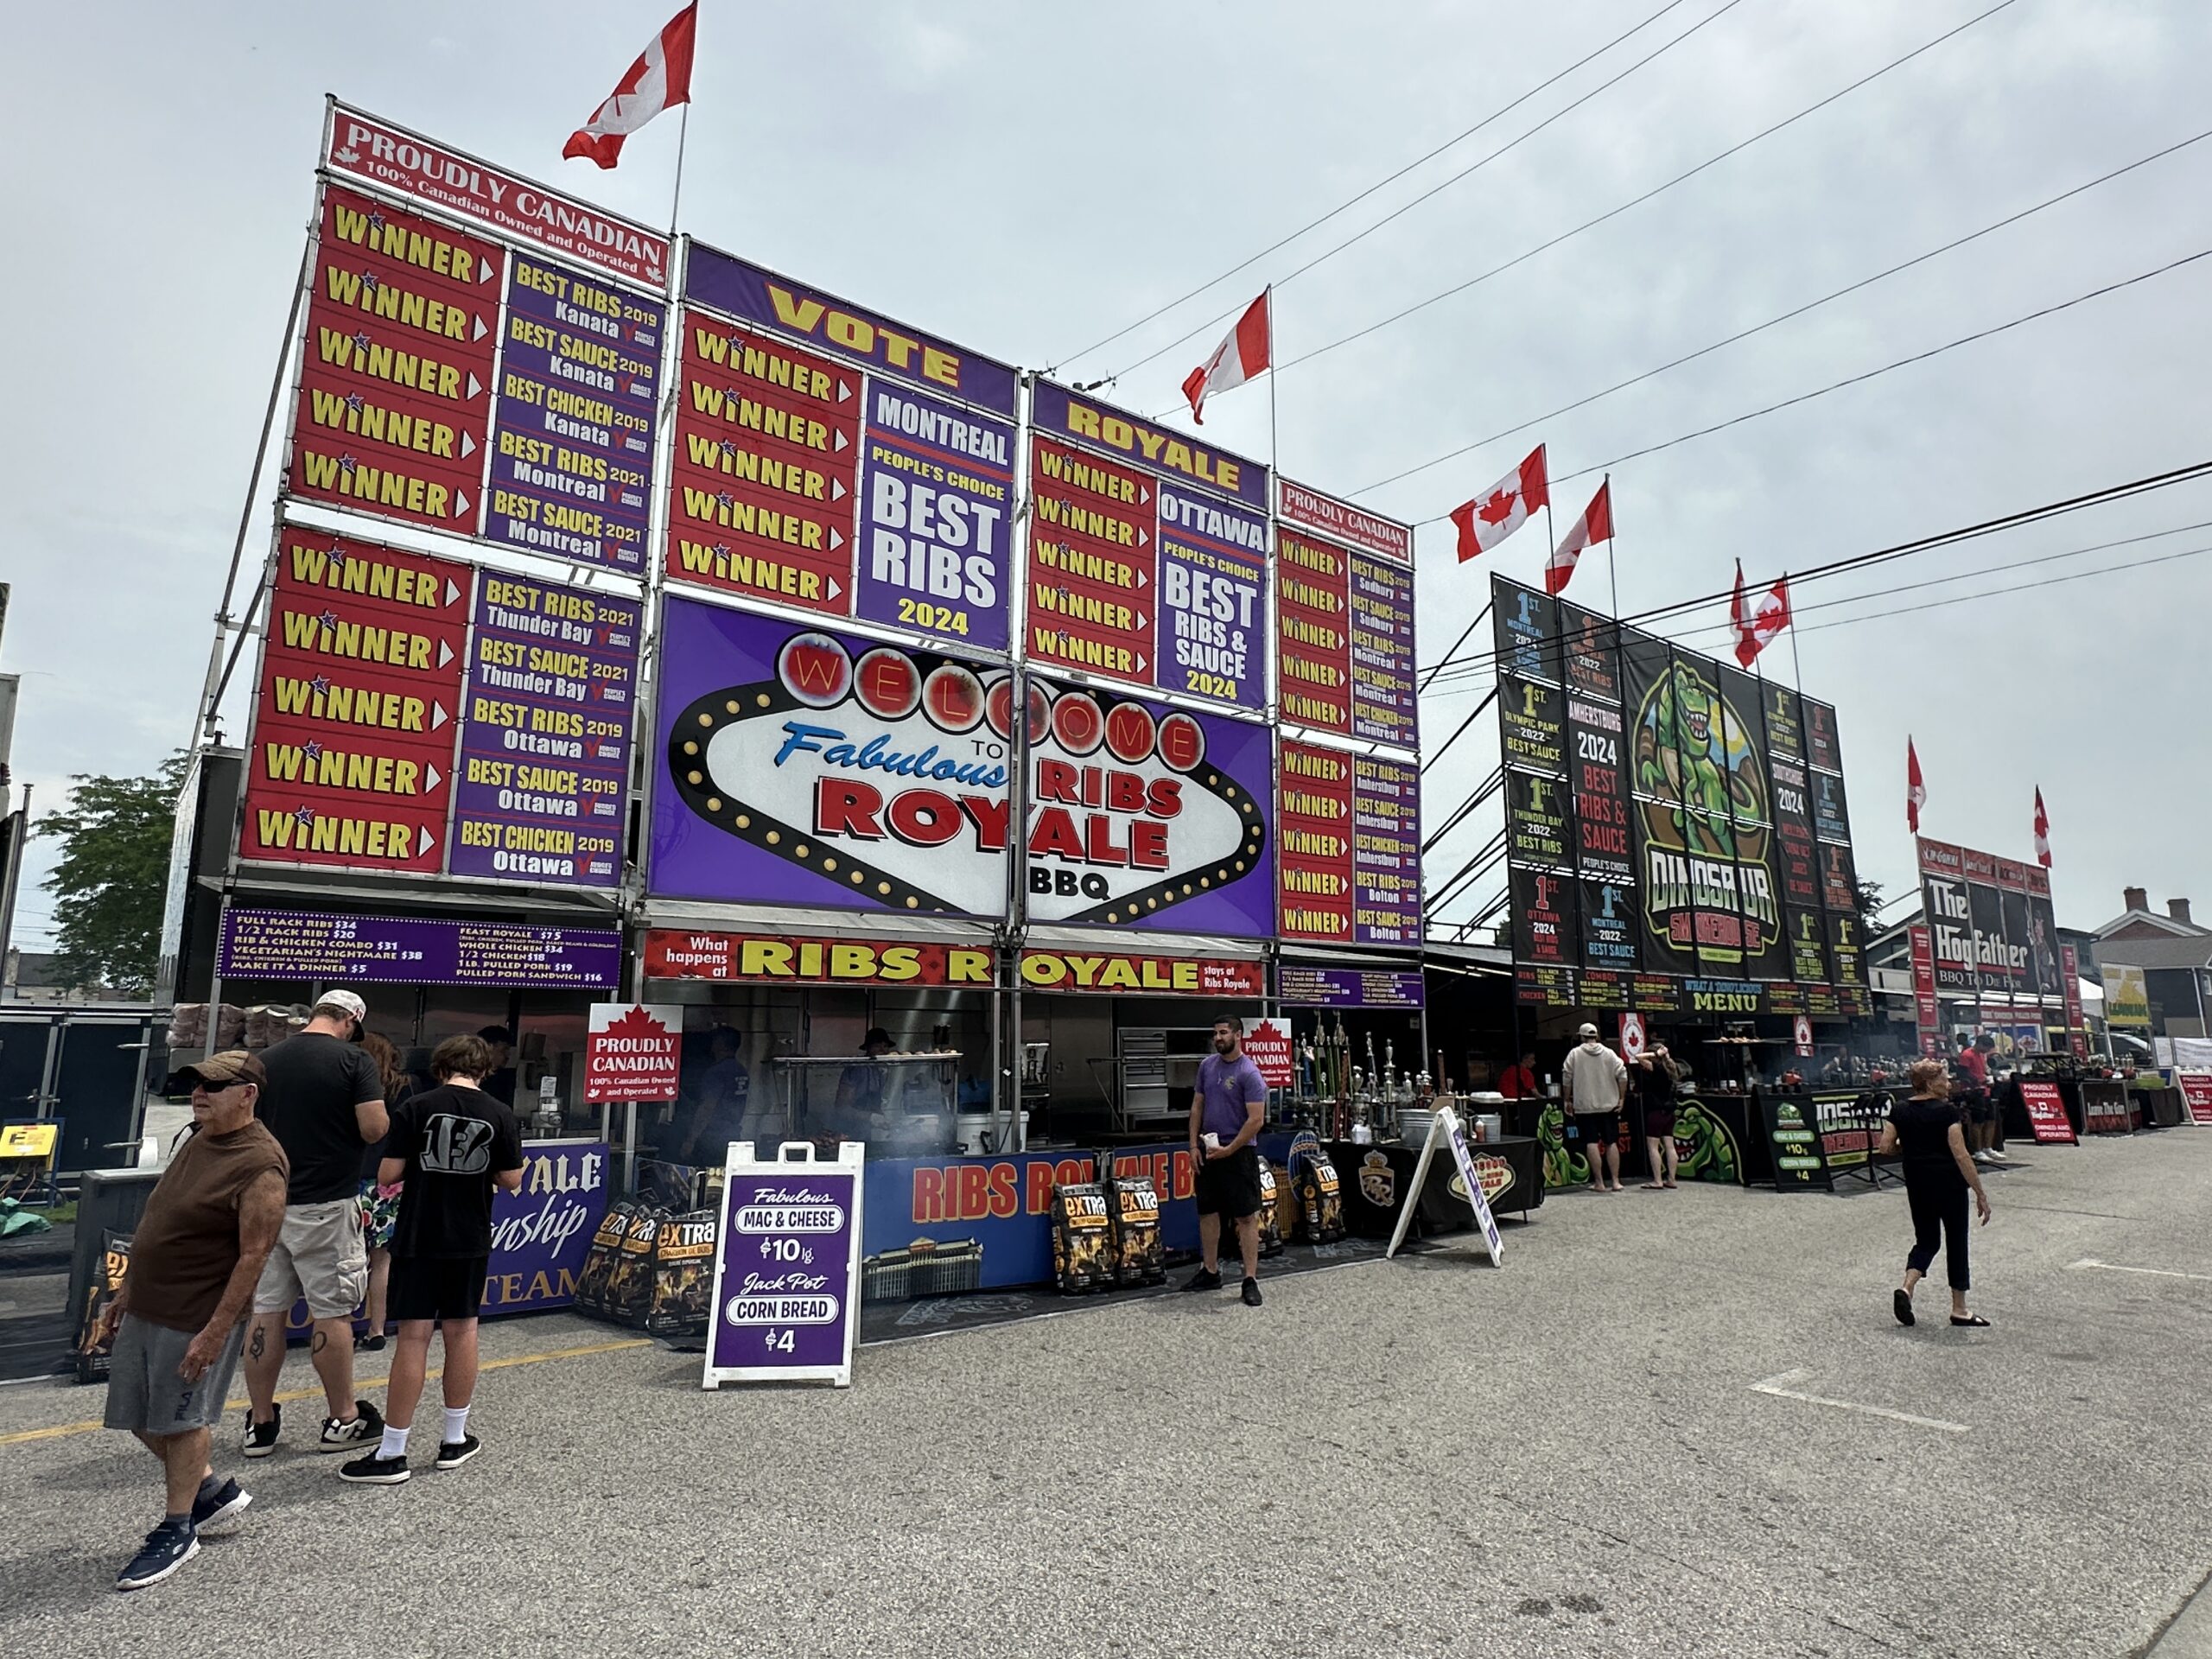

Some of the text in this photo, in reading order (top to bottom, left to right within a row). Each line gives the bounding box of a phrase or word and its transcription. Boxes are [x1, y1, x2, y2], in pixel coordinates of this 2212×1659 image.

[348, 123, 660, 265] PROUDLY CANADIAN
[367, 162, 638, 273] 100% Canadian Owned and Operated
[517, 263, 657, 327] BEST RIBS 2019
[556, 303, 620, 339] Kanata
[767, 283, 961, 388] VOTE
[505, 374, 648, 433] BEST CHICKEN 2019
[544, 412, 610, 447] Kanata
[877, 393, 1008, 466] MONTREAL
[499, 431, 645, 487] BEST RIBS 2021
[1068, 401, 1239, 492] ROYALE
[513, 461, 606, 501] Montreal
[873, 446, 1004, 501] PEOPLE'S CHOICE
[873, 471, 1001, 556] BEST
[1160, 493, 1264, 552] OTTAWA
[1287, 488, 1404, 546] PROUDLY CANADIAN
[873, 528, 995, 608] RIBS
[1165, 541, 1259, 582] PEOPLE'S CHOICE
[1351, 558, 1395, 586] BEST RIBS
[486, 579, 634, 626] BEST RIBS 2021
[1166, 561, 1257, 628] BEST
[1359, 577, 1394, 599] Sudbury
[487, 606, 593, 646] Thunder Bay
[898, 598, 969, 636] 2024
[1174, 610, 1247, 653] RIBS &
[1507, 619, 1544, 638] MONTREAL
[1176, 638, 1246, 680] SAUCE
[1186, 670, 1237, 700] 2024
[474, 697, 623, 738] BEST RIBS 2019
[1357, 721, 1398, 741] Montreal
[1505, 710, 1560, 734] OLYMPIC PARK
[1568, 700, 1622, 733] AMHERSTBURG
[504, 730, 582, 760] Ottawa
[774, 721, 1010, 788] Fabulous
[971, 740, 1003, 760] TO
[1507, 736, 1560, 761] BEST SAUCE
[1578, 731, 1618, 766] 2024
[1356, 760, 1400, 782] BEST RIBS
[1583, 764, 1617, 795] BEST
[1037, 757, 1183, 819] RIBS
[1778, 787, 1804, 815] 2024
[1514, 809, 1563, 827] THUNDER BAY
[1580, 792, 1626, 825] RIBS &
[461, 821, 614, 855] BEST CHICKEN 2019
[1516, 834, 1562, 854] BEST RIBS
[1583, 823, 1627, 855] SAUCE
[493, 850, 573, 876] Ottawa
[1610, 860, 1630, 873] CHOICE
[1029, 866, 1110, 900] BBQ
[1357, 871, 1401, 890] BEST RIBS
[1650, 850, 1774, 925] DINOSAUR
[1370, 889, 1400, 904] Bolton
[1928, 879, 1968, 919] The
[237, 916, 266, 925] FULL
[335, 921, 357, 930] $34
[1528, 910, 1560, 923] OTTAWA
[1534, 922, 1555, 935] 2024
[1592, 918, 1626, 930] MONTREAL
[325, 950, 397, 960] NIGHTMARE
[401, 951, 423, 960] $38
[544, 945, 563, 954] $34
[667, 949, 728, 966] happens
[690, 937, 728, 951] What
[1588, 942, 1636, 958] BEST SAUCE
[1935, 924, 2028, 970] Hogfather
[712, 965, 728, 977] at
[741, 939, 923, 981] RIBS
[1204, 966, 1235, 976] stays at
[528, 972, 582, 981] SANDWICH
[584, 973, 602, 982] $16
[1205, 978, 1250, 988] Ribs Royale
[1586, 971, 1618, 982] COMBOS
[1939, 969, 1963, 987] BBQ
[1694, 992, 1757, 1011] MENU
[595, 1038, 674, 1052] PROUDLY
[1245, 1042, 1287, 1052] PROUDLY
[593, 1057, 675, 1072] CANADIAN
[753, 1188, 835, 1205] Fabulous
[912, 1162, 1019, 1223] RIBS
[744, 1210, 836, 1228] MAC & CHEESE
[760, 1236, 800, 1262] $10
[740, 1272, 830, 1295] Jack Pot
[737, 1300, 828, 1319] CORN BREAD
[766, 1327, 795, 1353] $4
